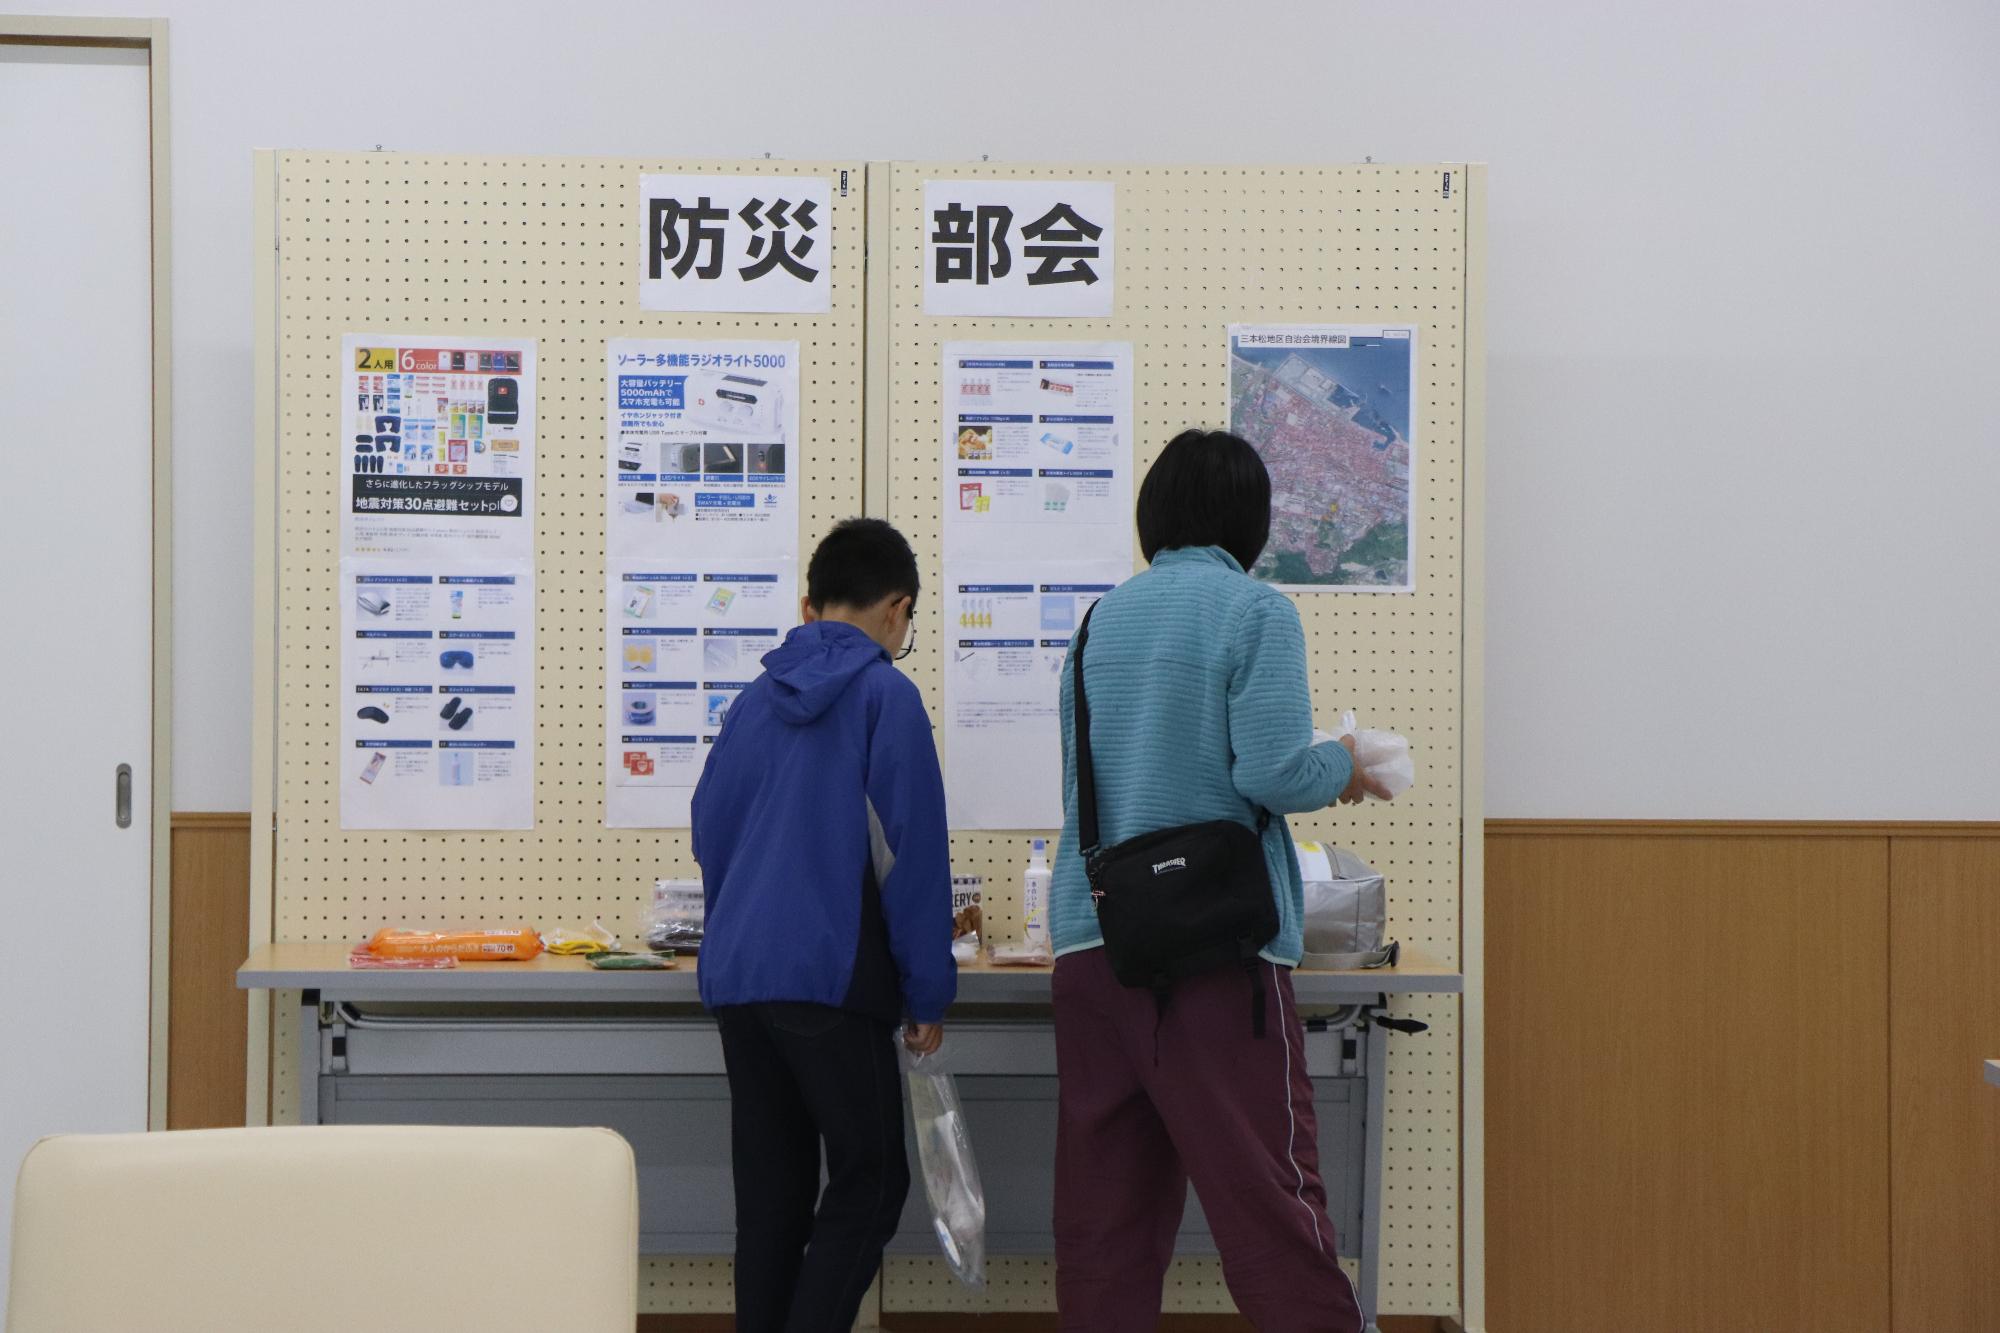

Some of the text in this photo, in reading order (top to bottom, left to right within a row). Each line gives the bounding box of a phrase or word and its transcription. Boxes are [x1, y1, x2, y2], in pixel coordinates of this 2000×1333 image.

[648, 196, 820, 283] 防災
[932, 202, 1104, 286] 部会
[1241, 334, 1347, 344] 三本松地区自治会境界線図
[358, 349, 393, 369] 2人用
[402, 350, 437, 370] 6 color
[618, 353, 785, 368] ソーラー多機能ラジオライト5000
[621, 389, 672, 397] 5000mAhで
[364, 479, 509, 491] さらに進化したフラッグシップモデル
[355, 496, 503, 513] 地震対策30点避難セットpl
[952, 892, 971, 908] ERY
